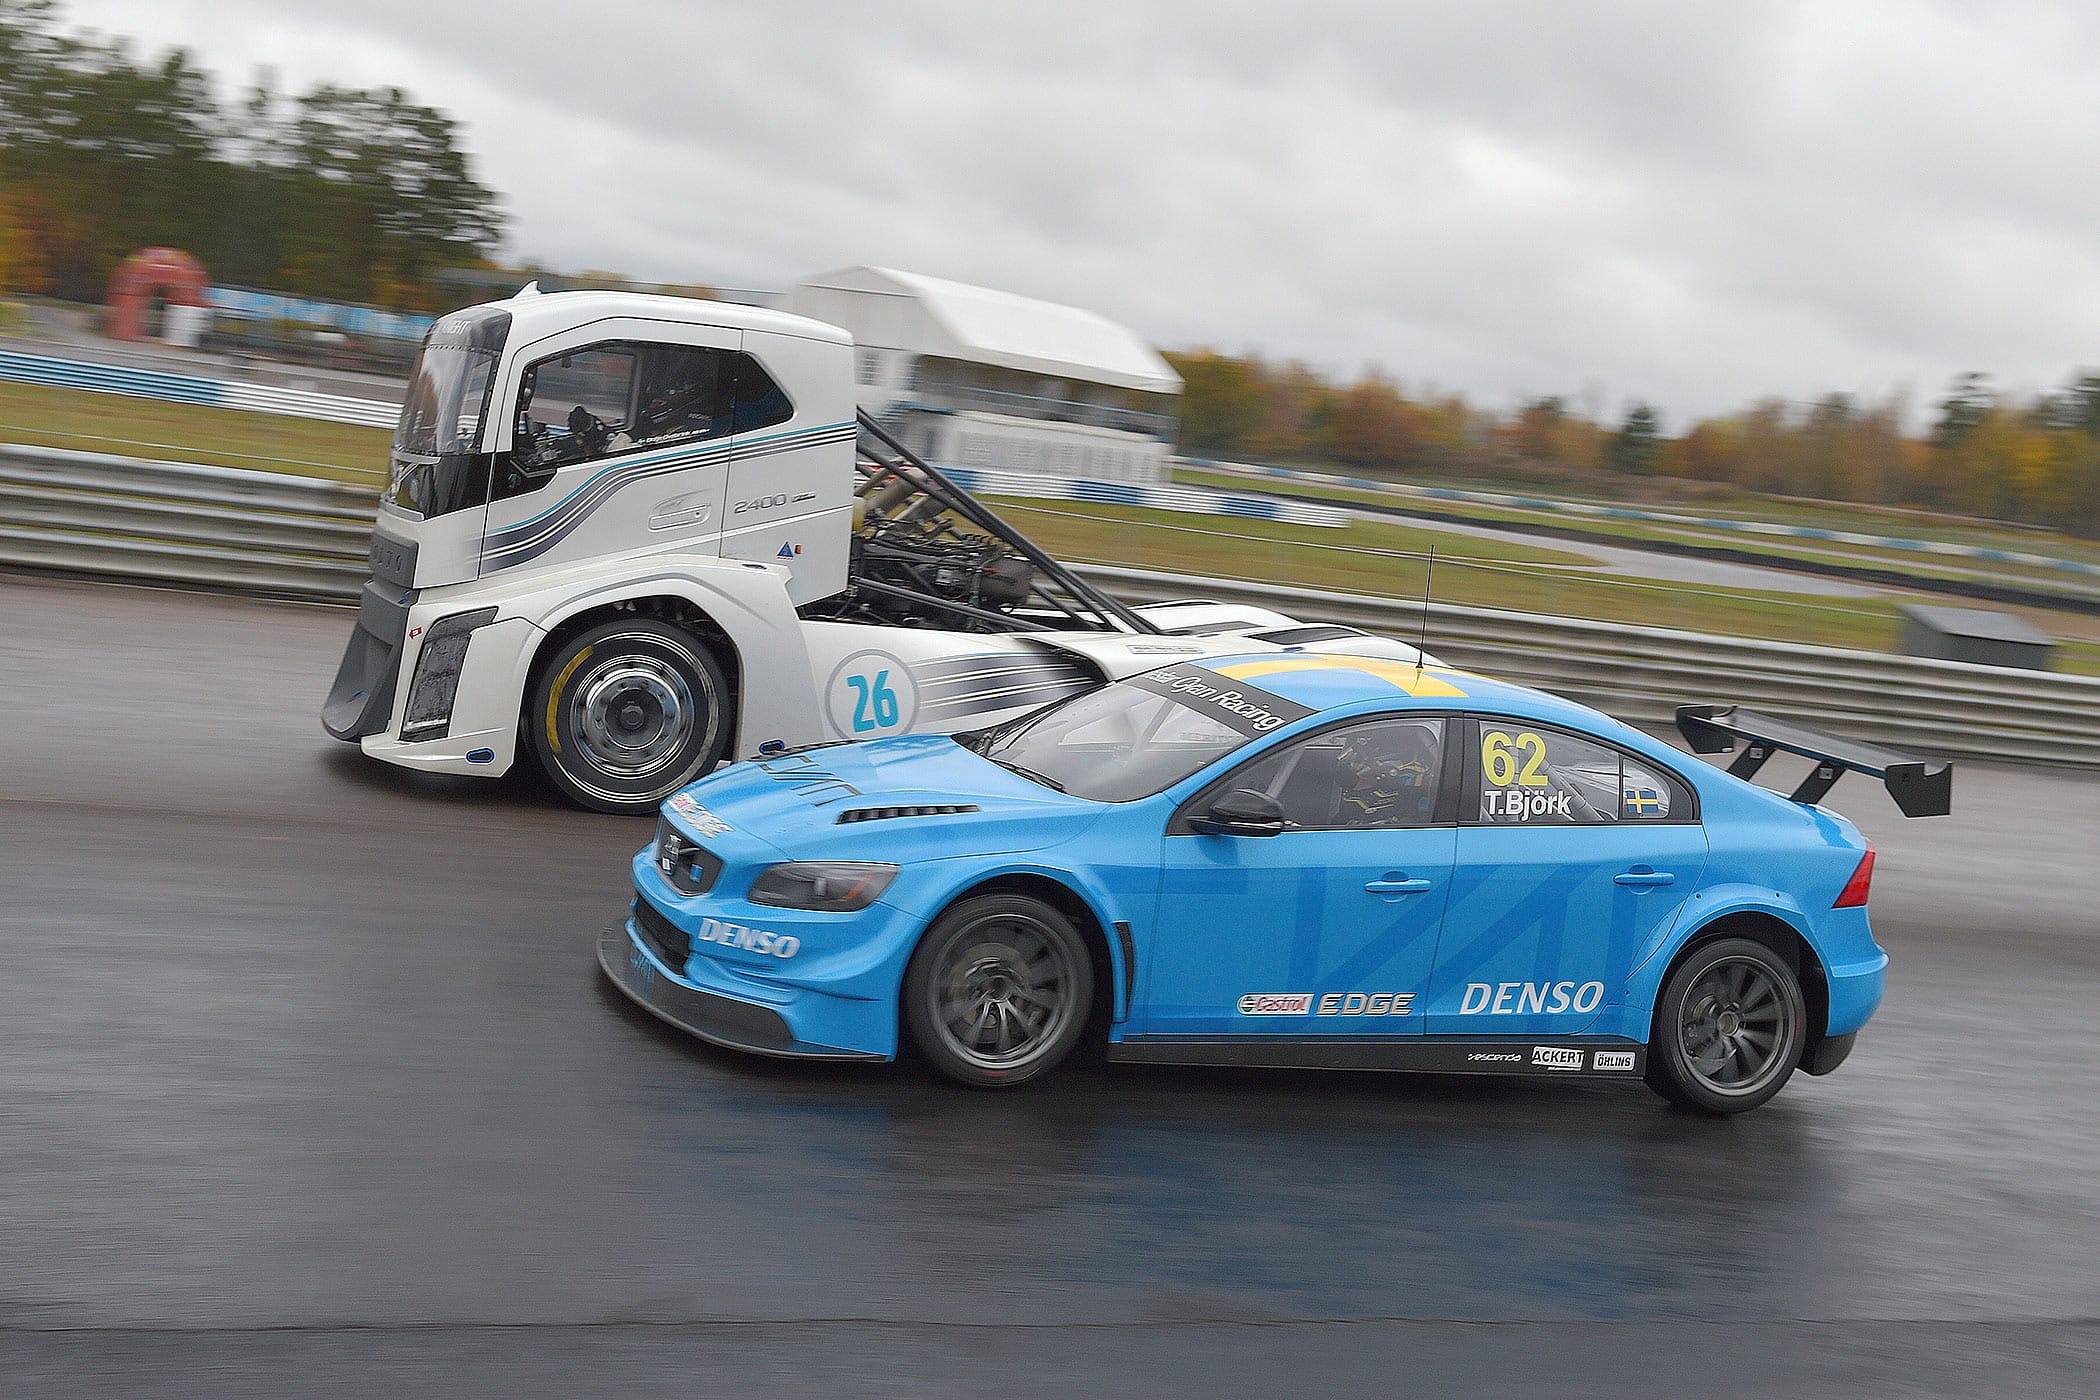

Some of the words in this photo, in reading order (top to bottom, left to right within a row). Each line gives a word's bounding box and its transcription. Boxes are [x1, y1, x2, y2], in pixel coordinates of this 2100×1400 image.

[734, 493, 786, 513] 2400
[847, 669, 899, 733] 26
[1208, 690, 1287, 731] Racing
[1482, 731, 1549, 787] 62
[1484, 790, 1572, 822] T.Björk
[698, 917, 801, 959] DENSO
[1256, 995, 1306, 1012] Castrol
[1316, 993, 1418, 1015] EDGE
[1459, 981, 1605, 1015] DENSO
[1532, 1050, 1584, 1065] ACKERT
[1597, 1053, 1631, 1067] ÖHLINS
